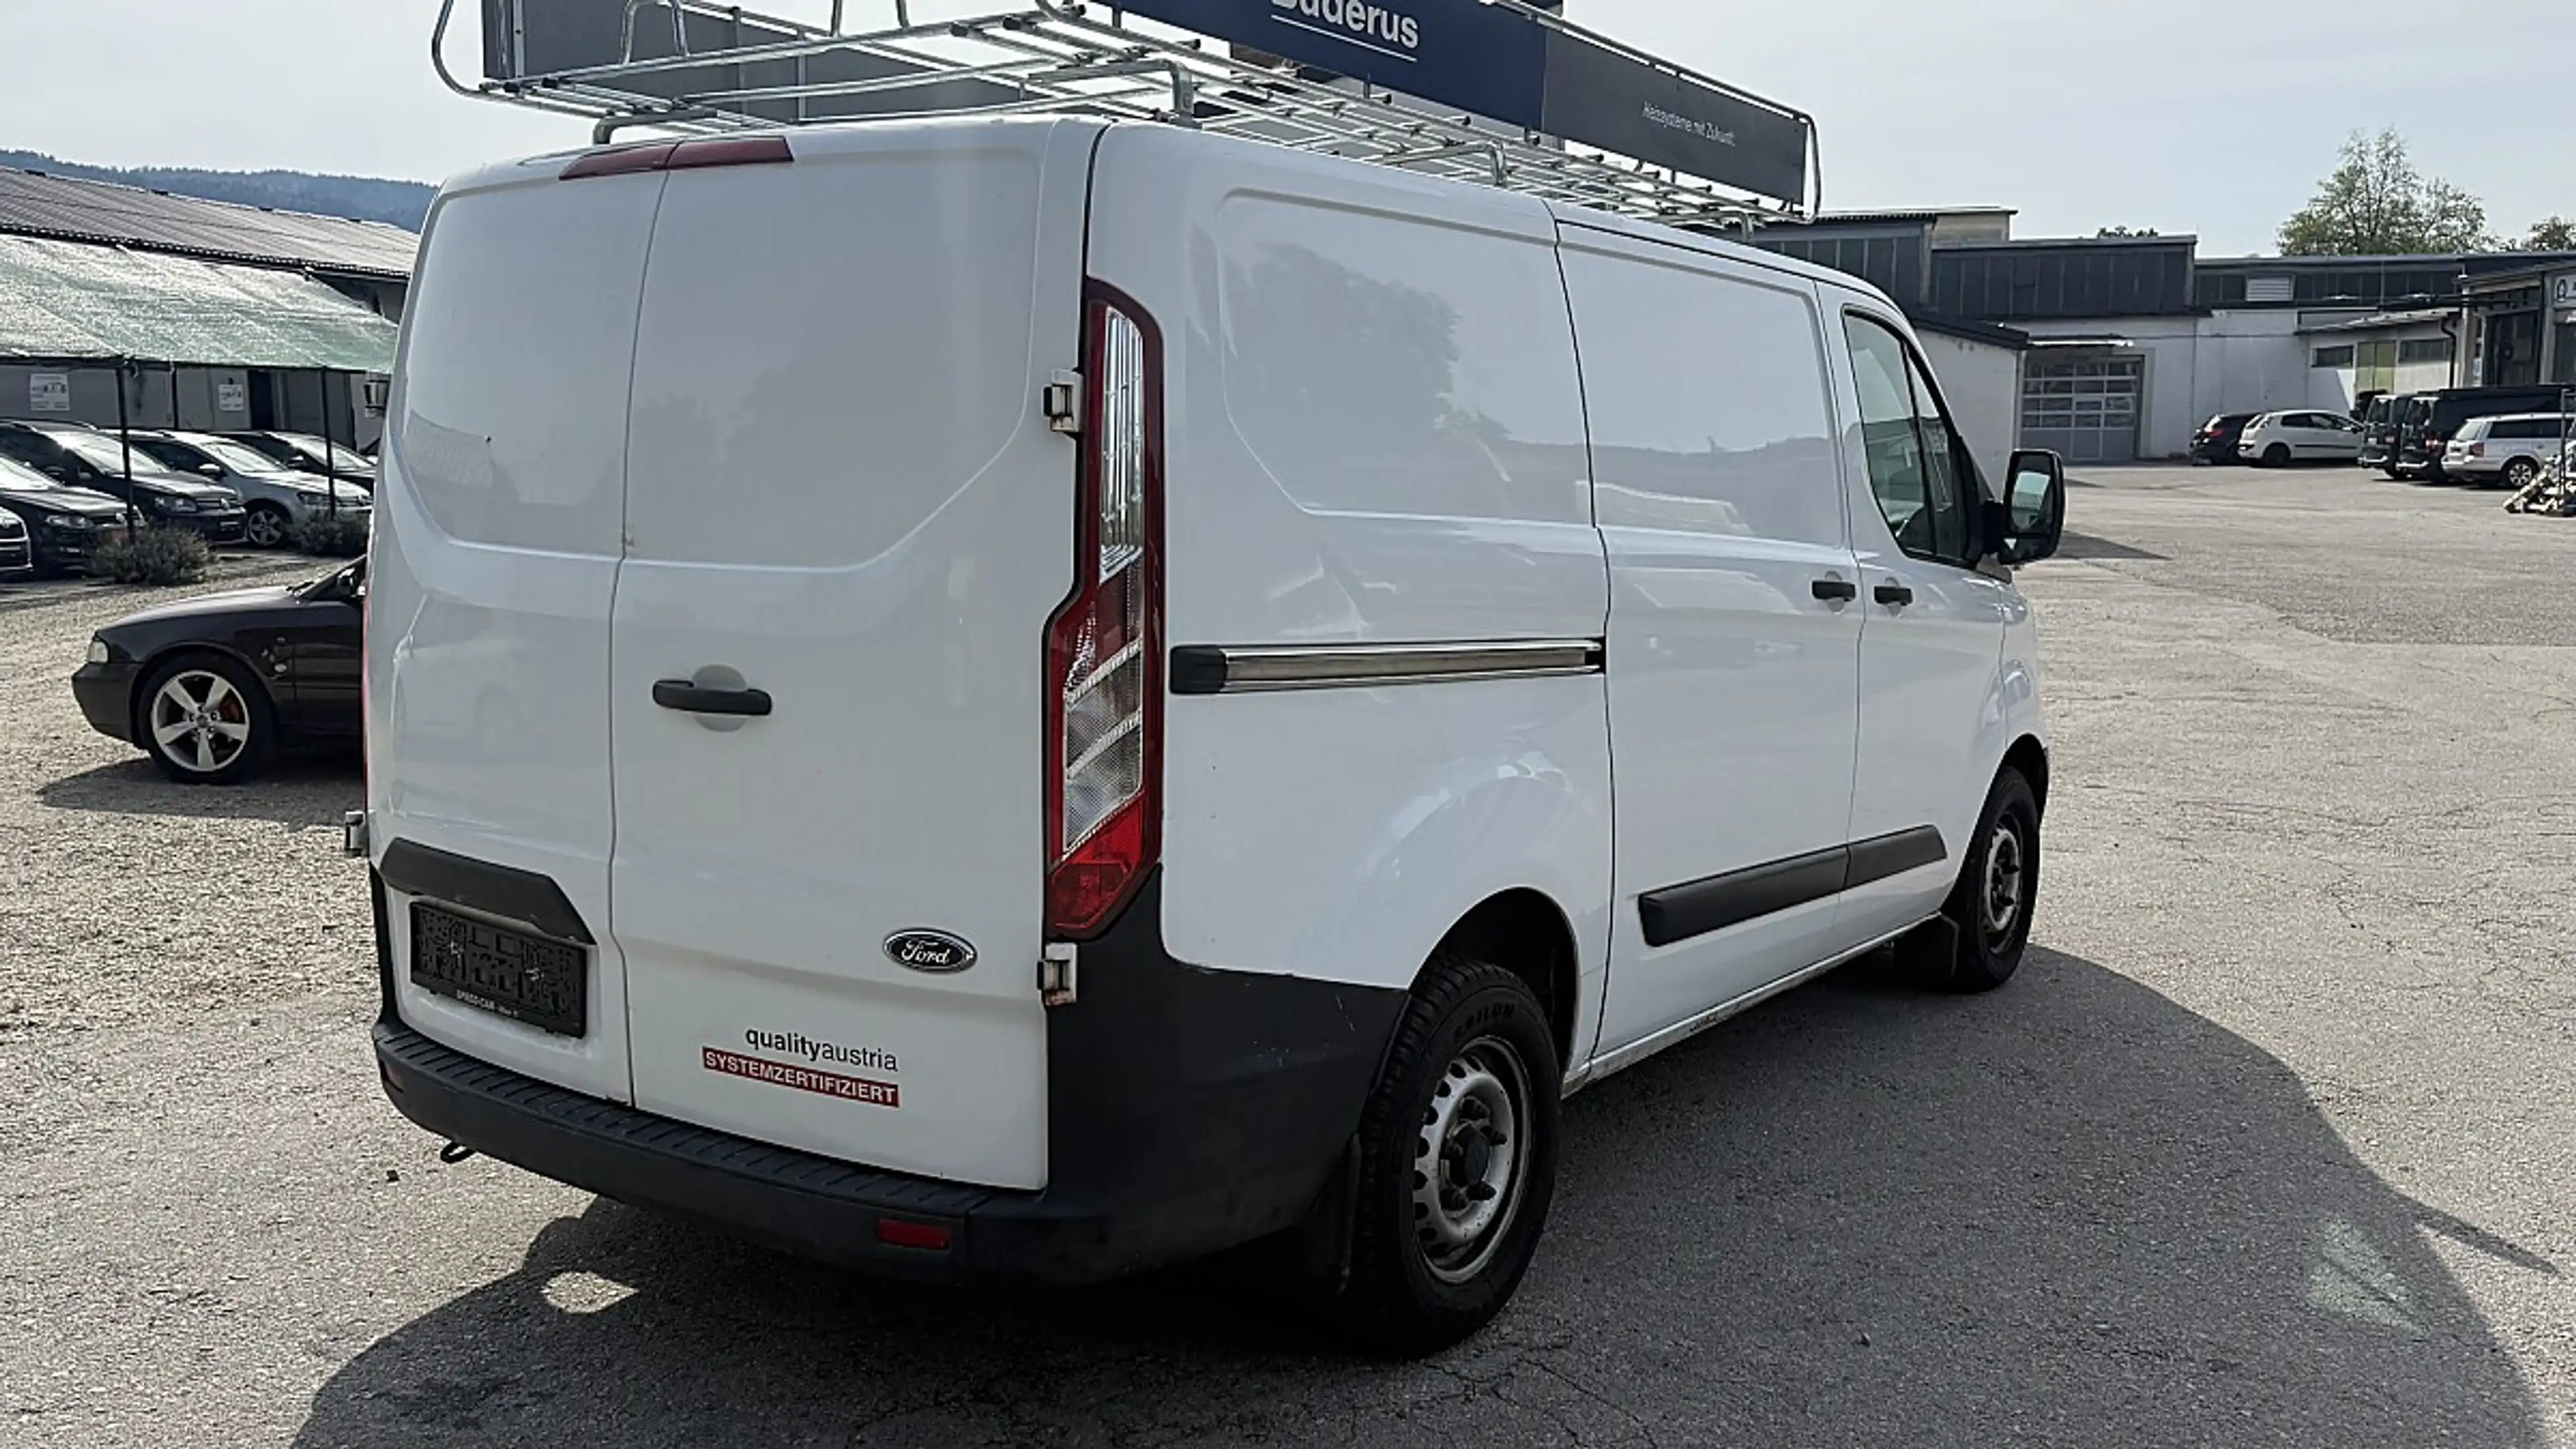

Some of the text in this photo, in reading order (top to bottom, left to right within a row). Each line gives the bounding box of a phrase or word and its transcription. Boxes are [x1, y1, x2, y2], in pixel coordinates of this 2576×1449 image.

[1271, 0, 1419, 48] uderus
[901, 940, 951, 965] Ford
[745, 1028, 898, 1072] qualityaustria
[705, 1051, 896, 1104] SYSTEMZERTIFIZIERT
